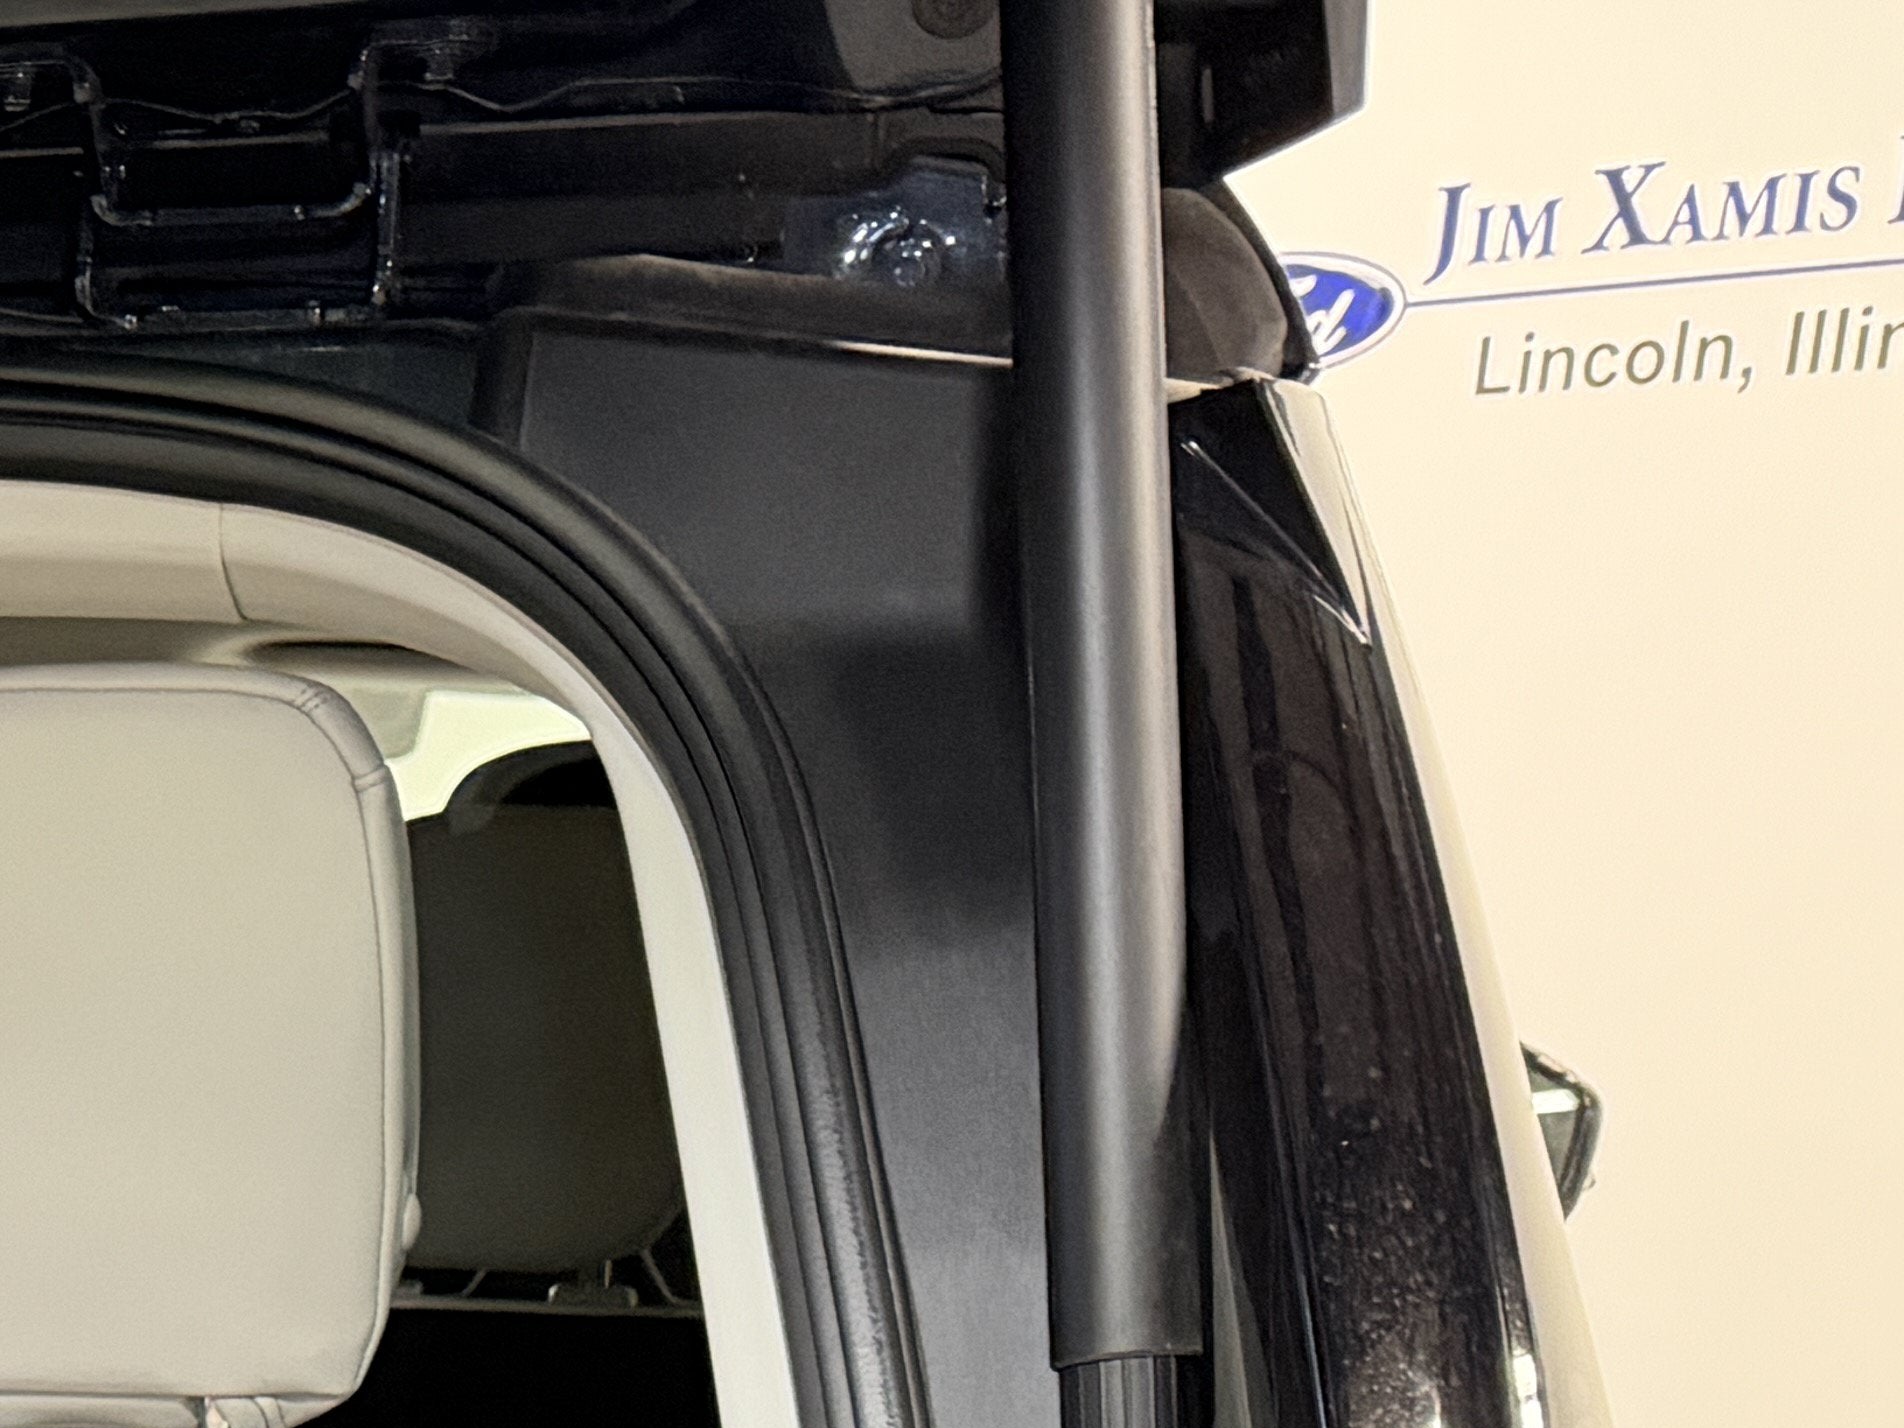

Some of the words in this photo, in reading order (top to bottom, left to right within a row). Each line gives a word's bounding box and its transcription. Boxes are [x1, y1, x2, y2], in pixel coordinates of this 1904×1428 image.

[1423, 183, 1563, 285] JIM
[1581, 160, 1861, 254] XAMIS
[1475, 320, 1753, 395] Lincoln,
